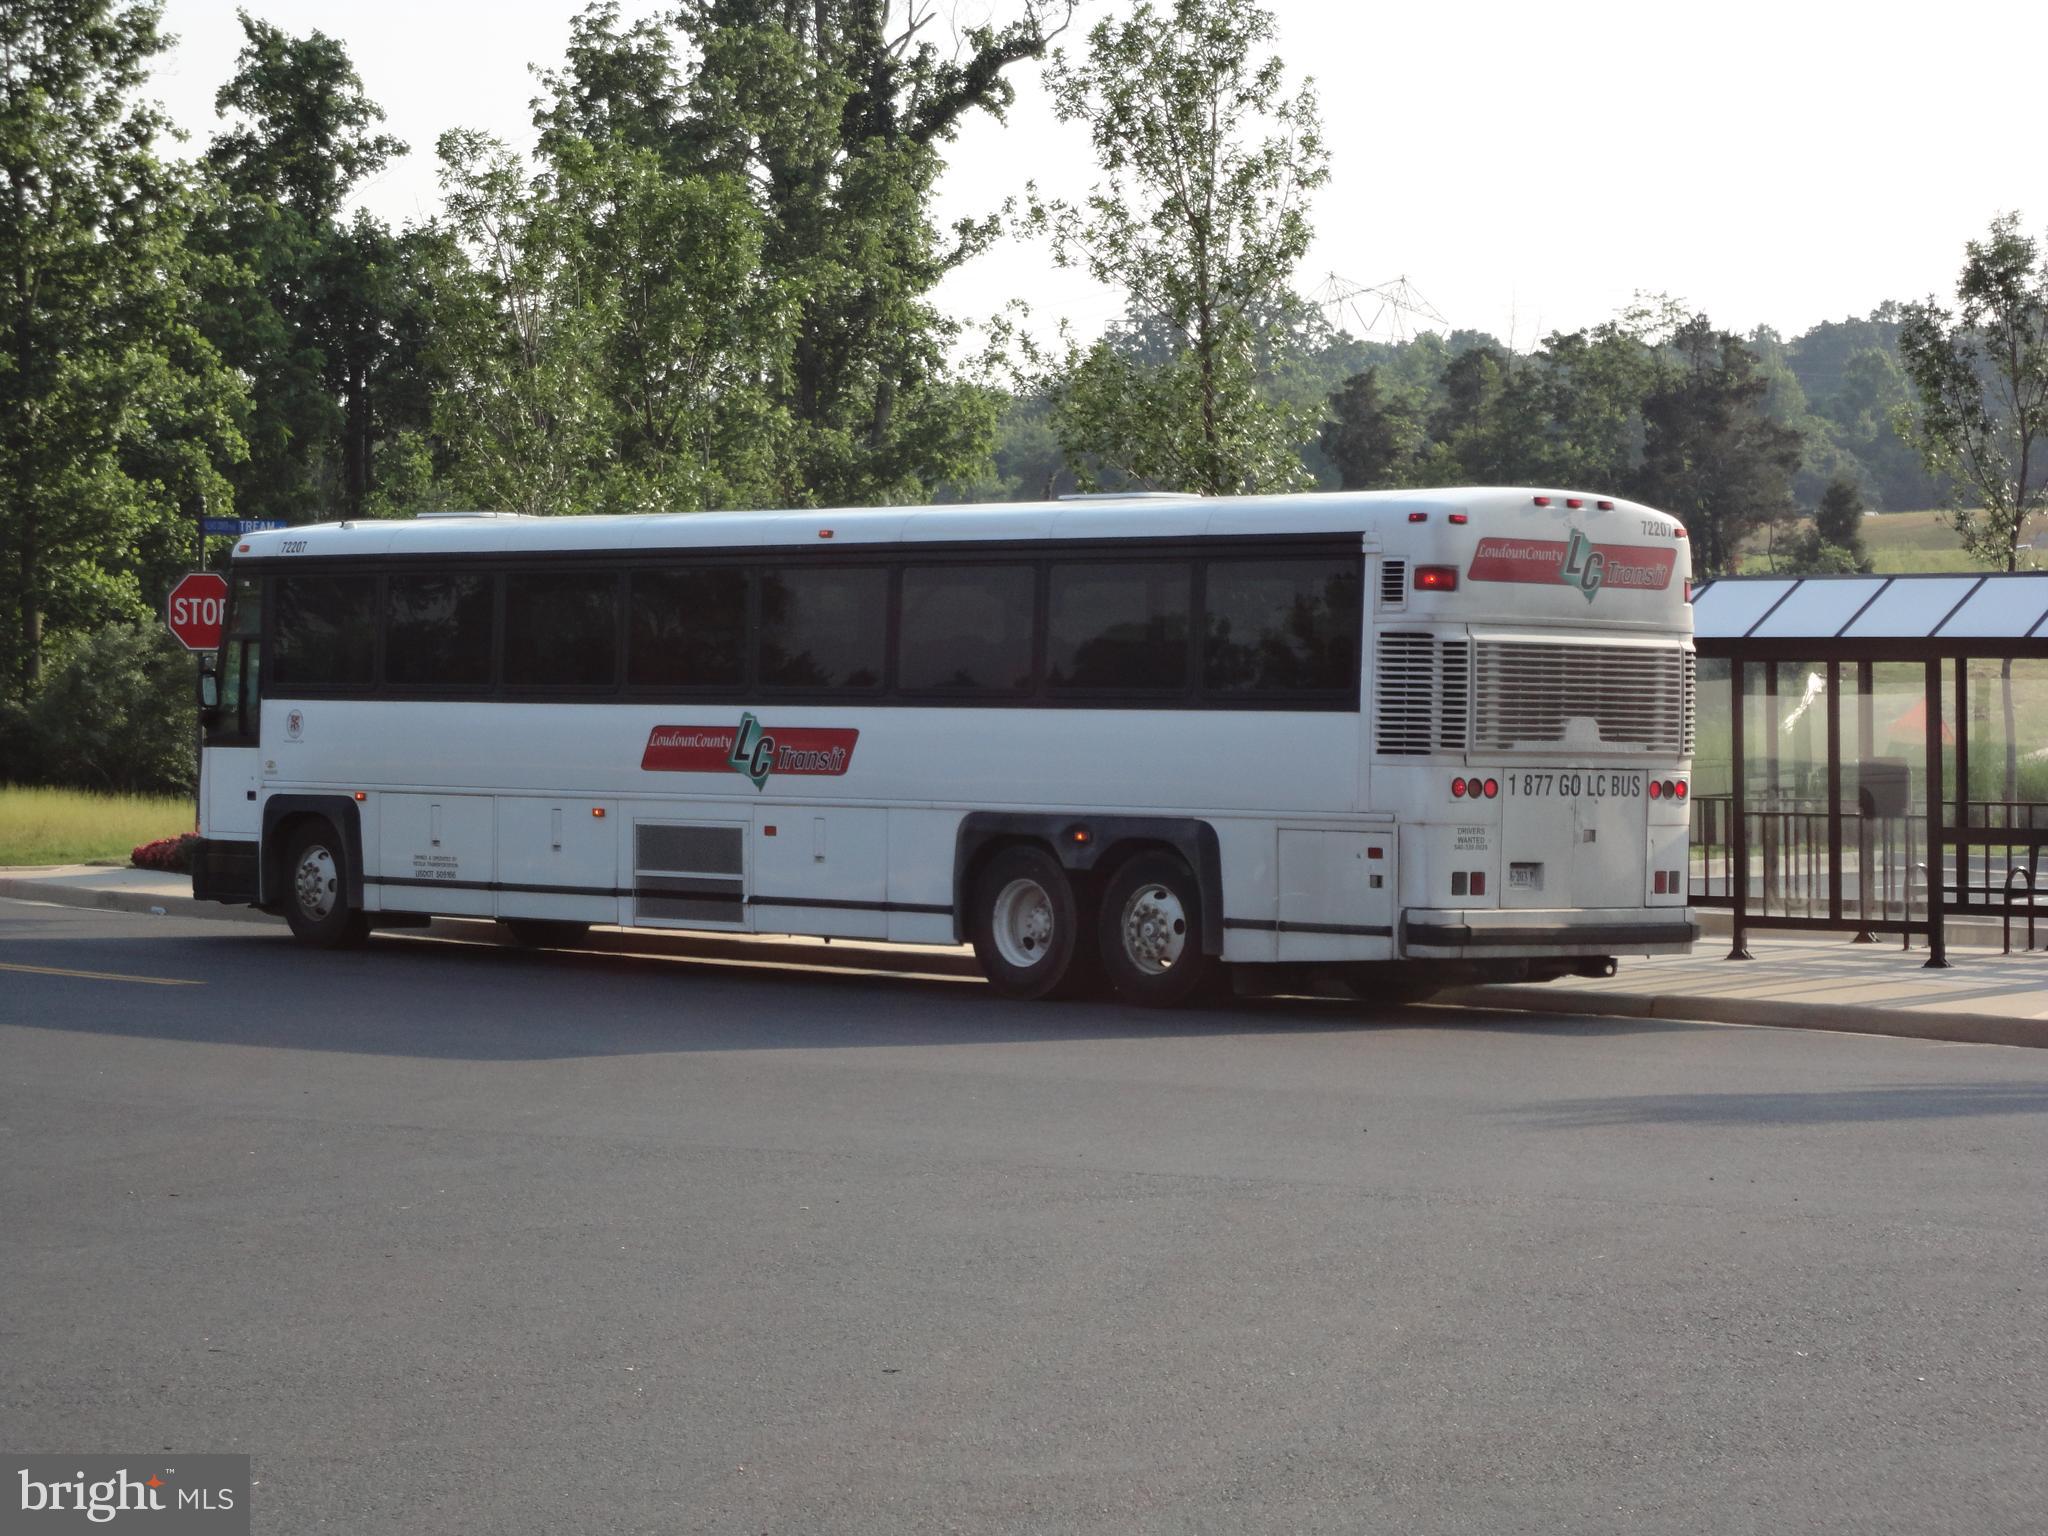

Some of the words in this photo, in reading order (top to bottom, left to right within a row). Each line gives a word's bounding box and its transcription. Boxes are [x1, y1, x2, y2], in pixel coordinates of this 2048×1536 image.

[1641, 520, 1674, 537] 72207
[281, 541, 308, 553] 72207
[1607, 561, 1668, 586] Transit
[778, 745, 846, 771] Transit
[1509, 773, 1516, 796] 1
[1524, 774, 1553, 796] 877
[1560, 774, 1581, 797] GO
[1587, 775, 1606, 797] LC
[1611, 775, 1641, 798] BUS
[1457, 827, 1486, 835] DRIVERS
